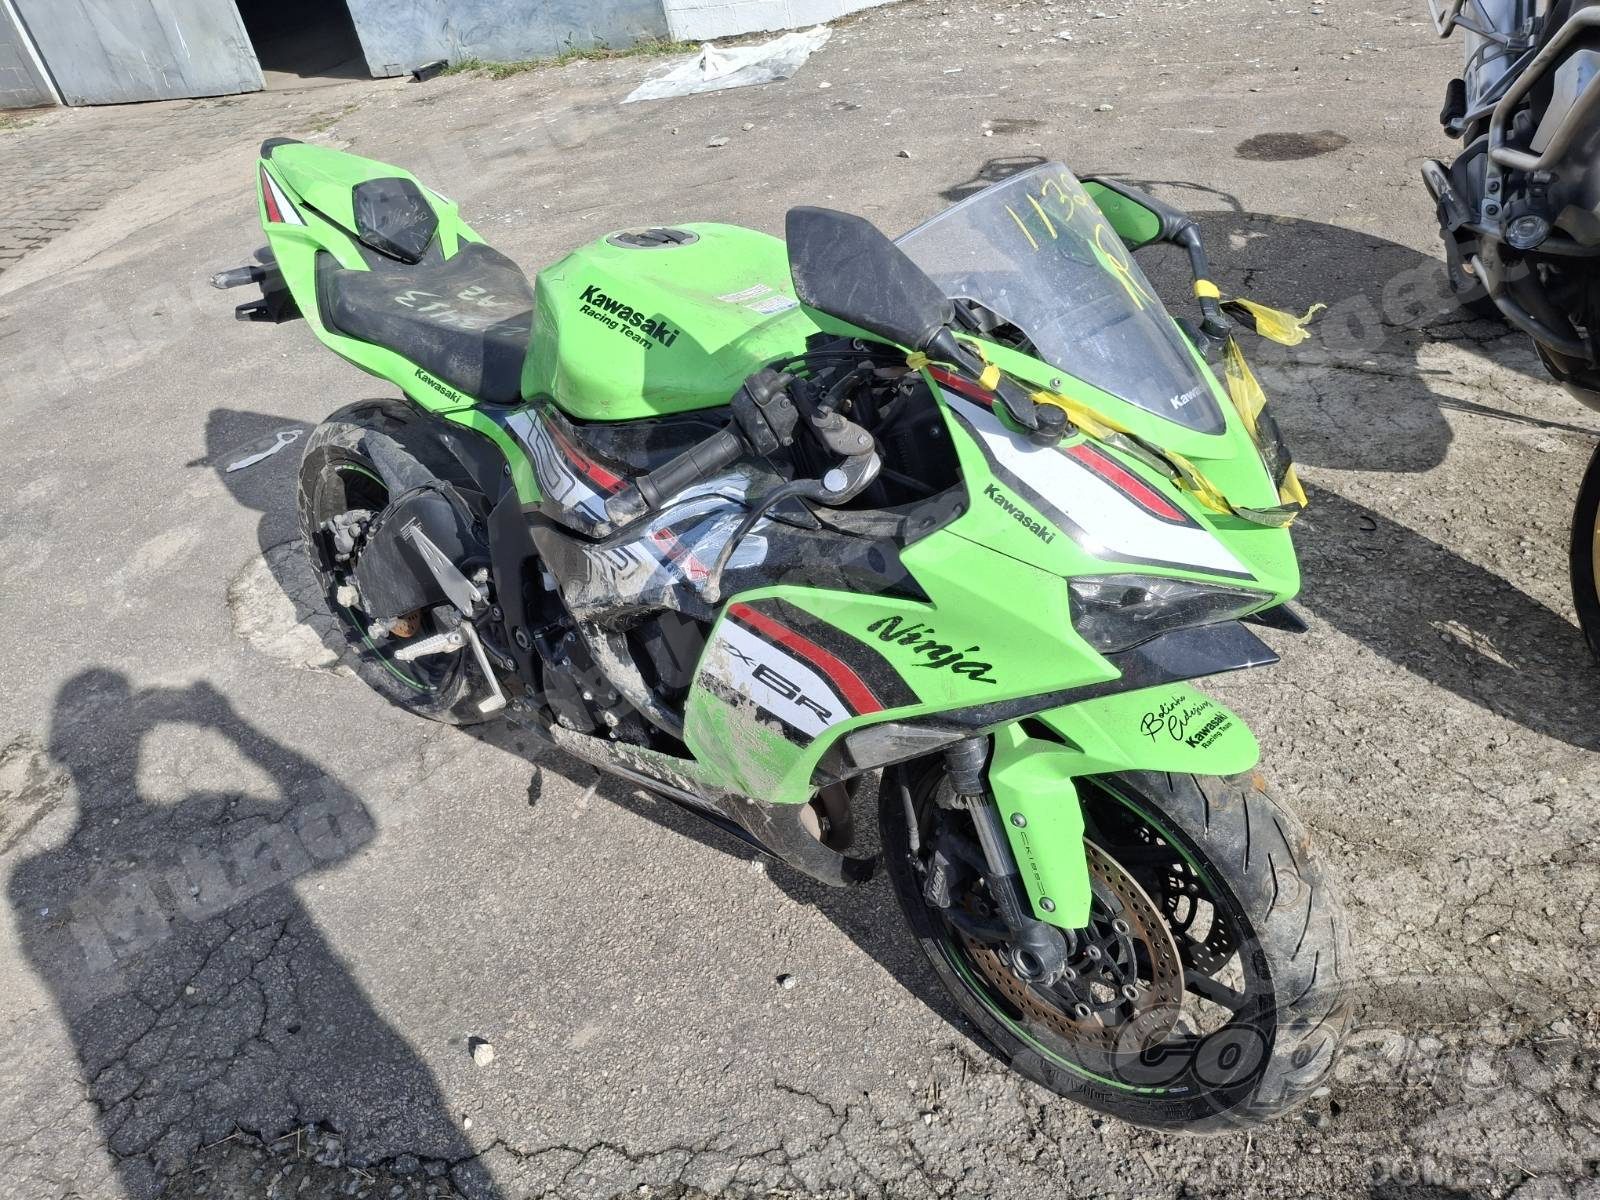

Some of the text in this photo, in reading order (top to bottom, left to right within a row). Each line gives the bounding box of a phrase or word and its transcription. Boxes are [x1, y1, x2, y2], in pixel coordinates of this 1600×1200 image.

[579, 284, 681, 348] Kawasaki
[579, 304, 654, 350] Racing Team
[414, 368, 462, 404] Kawasaki
[983, 483, 1057, 545] Kawasaki
[866, 615, 997, 685] Ninja
[1185, 711, 1229, 749] Kawasaki
[1201, 730, 1223, 749] Racing
